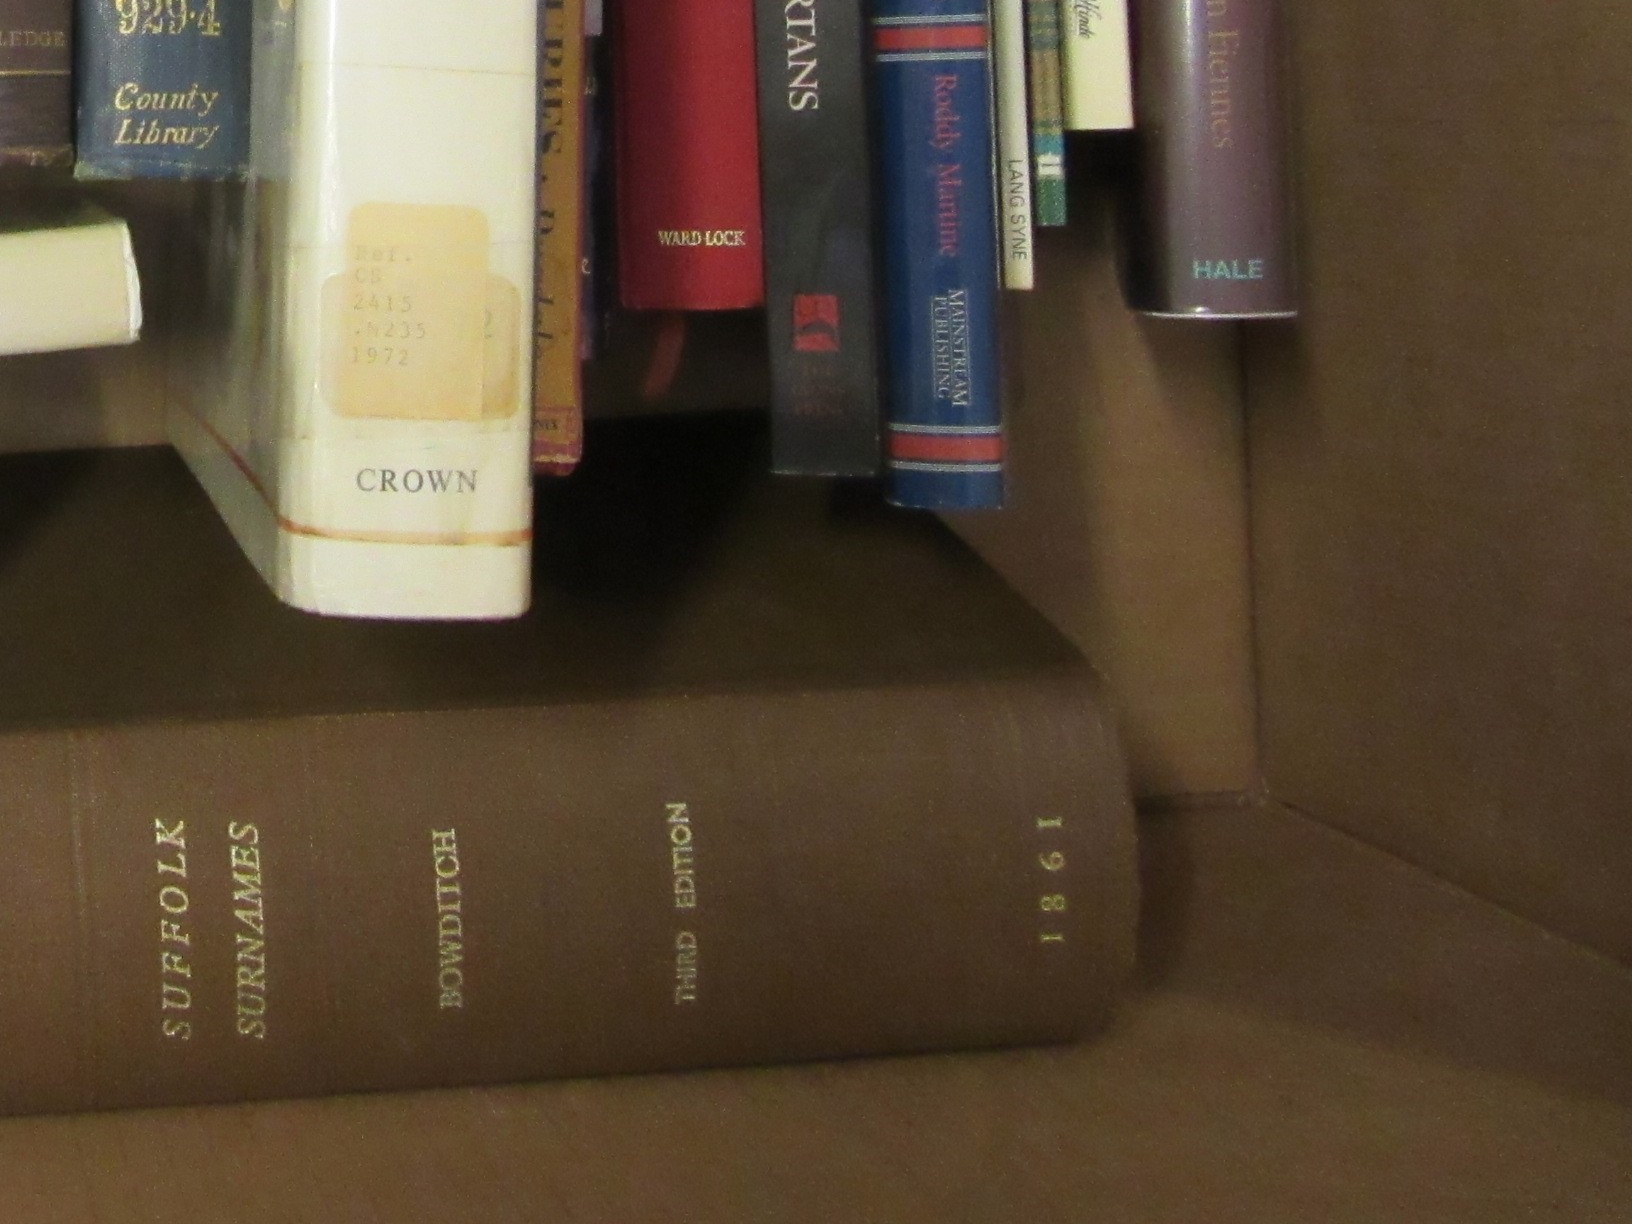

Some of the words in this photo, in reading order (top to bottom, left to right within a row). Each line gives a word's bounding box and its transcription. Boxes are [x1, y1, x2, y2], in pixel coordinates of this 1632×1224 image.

[114, 82, 219, 113] County
[114, 118, 218, 150] Library
[1008, 159, 1025, 206] LANG
[658, 230, 703, 248] WARD
[705, 230, 746, 248] LOCK
[1011, 214, 1028, 261] SYNE
[1192, 257, 1264, 279] HALE
[933, 296, 950, 400] PUBLISHING
[948, 289, 968, 408] MAINSTREAM
[356, 468, 479, 493] CROWN
[666, 802, 697, 909] EDITION
[154, 818, 191, 1041] SUFFOLK
[228, 821, 266, 1040] SURNAMES
[431, 828, 463, 1009] BOWDITCH
[674, 930, 698, 1005] THIRD
